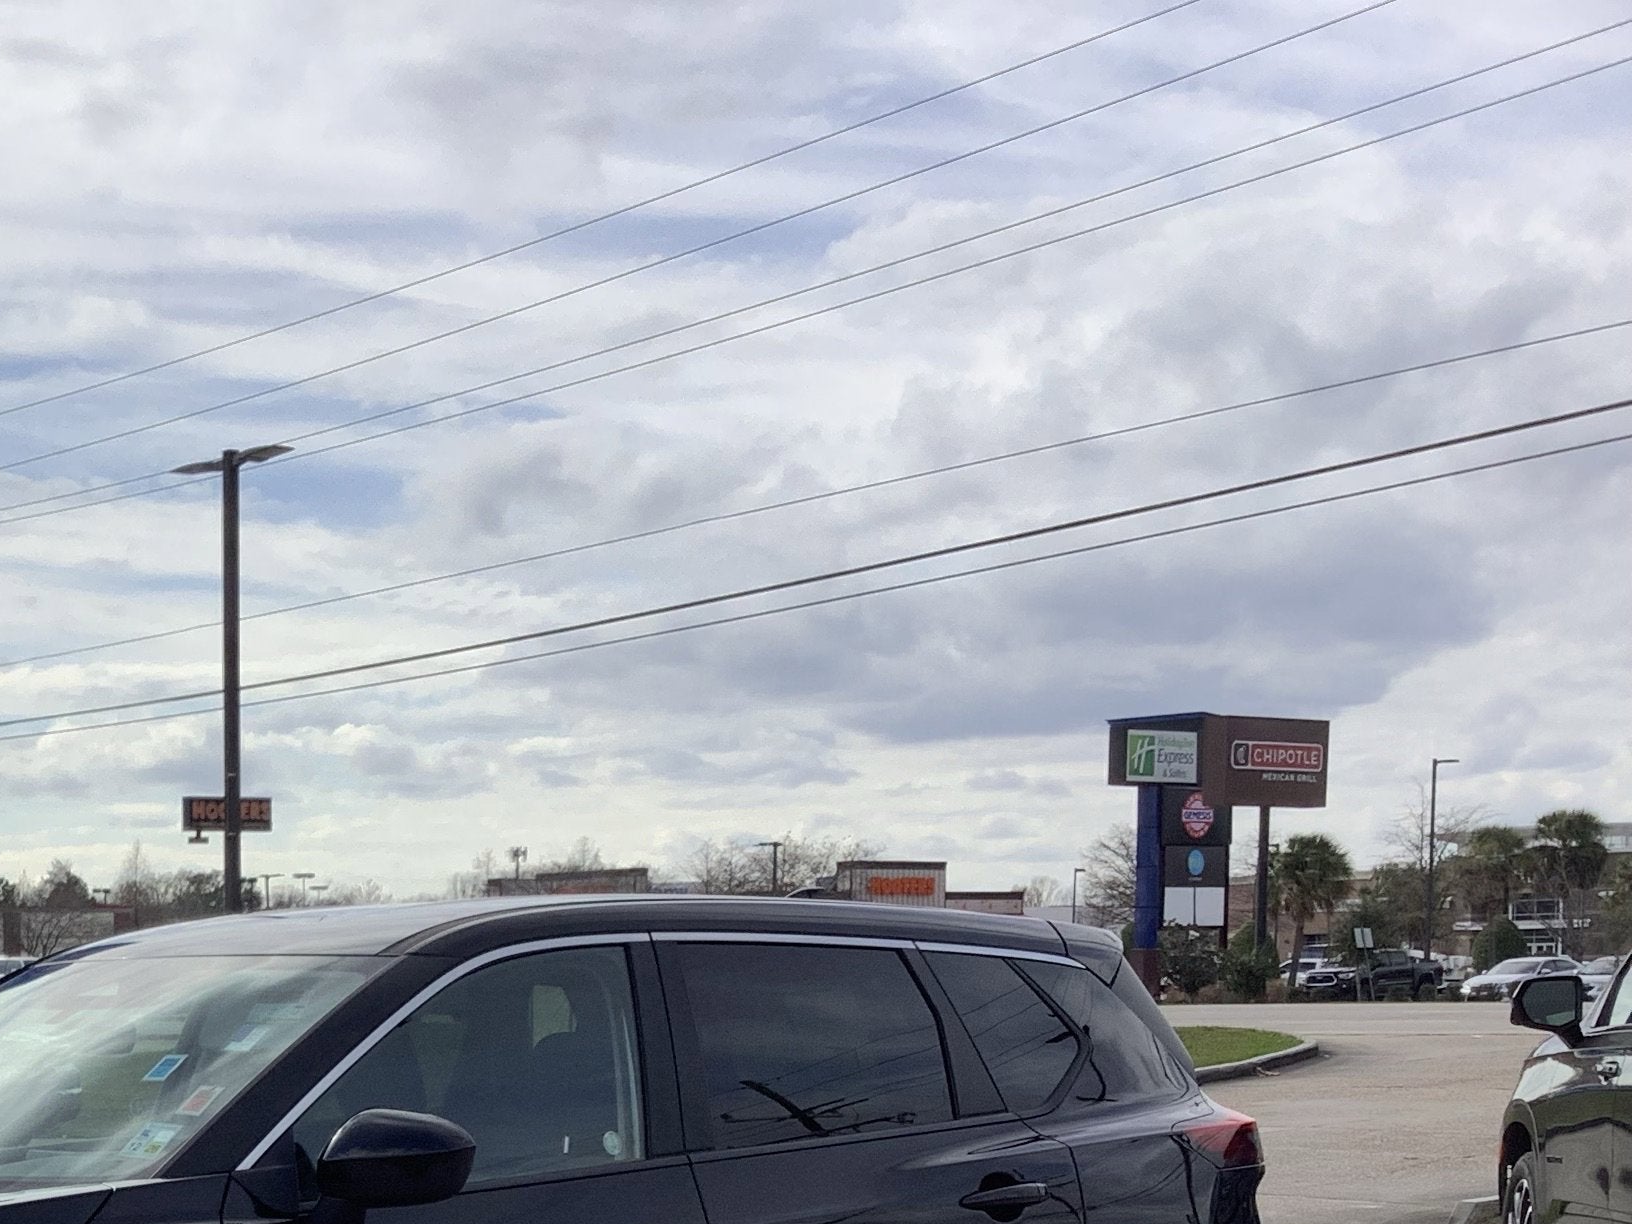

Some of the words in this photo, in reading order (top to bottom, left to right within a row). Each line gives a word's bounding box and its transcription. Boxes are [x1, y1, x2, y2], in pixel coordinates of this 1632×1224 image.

[1157, 748, 1194, 767] Express
[1253, 747, 1319, 766] CHIPOTLE
[1262, 772, 1295, 782] MEXICAN
[1296, 773, 1318, 783] GRILL
